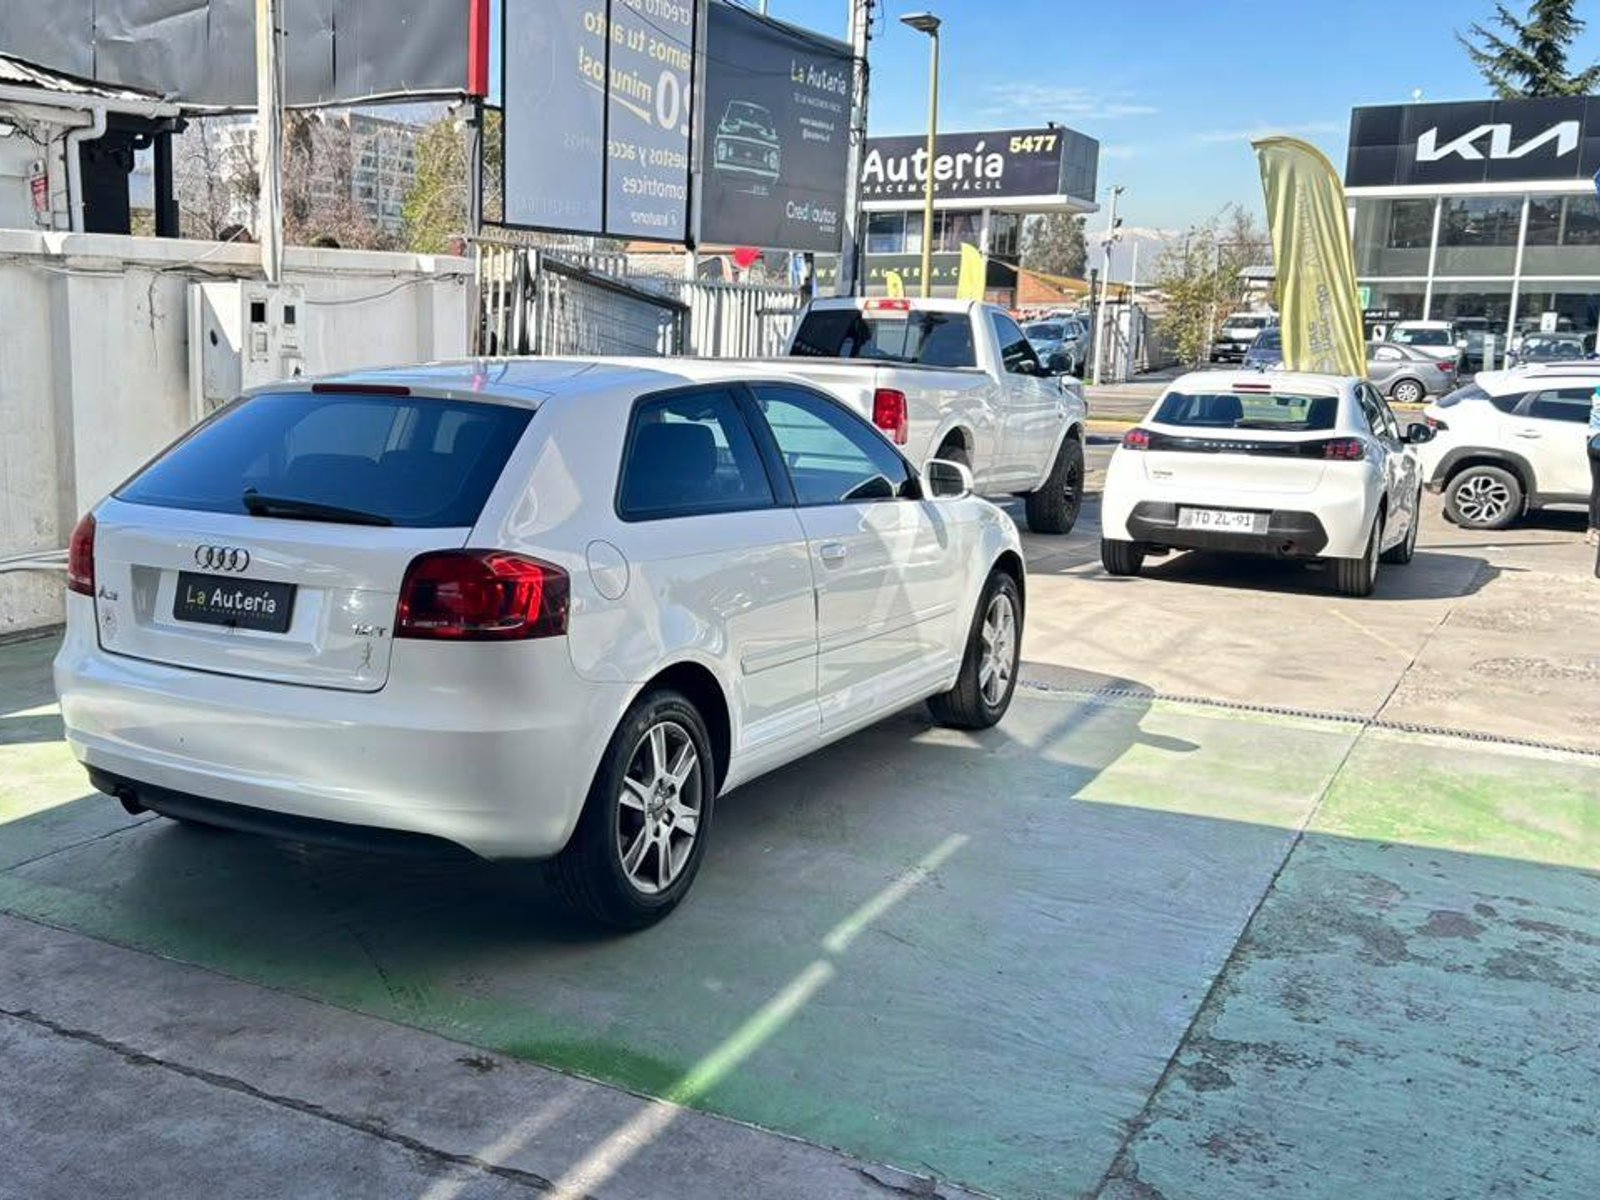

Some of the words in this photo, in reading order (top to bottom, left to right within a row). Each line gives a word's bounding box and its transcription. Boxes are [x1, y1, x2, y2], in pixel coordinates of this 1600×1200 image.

[791, 58, 805, 83] La
[1009, 135, 1057, 153] 5477
[1415, 120, 1580, 162] KIA
[861, 141, 1004, 183] Autería
[186, 584, 206, 605] La
[210, 588, 277, 613] Autería
